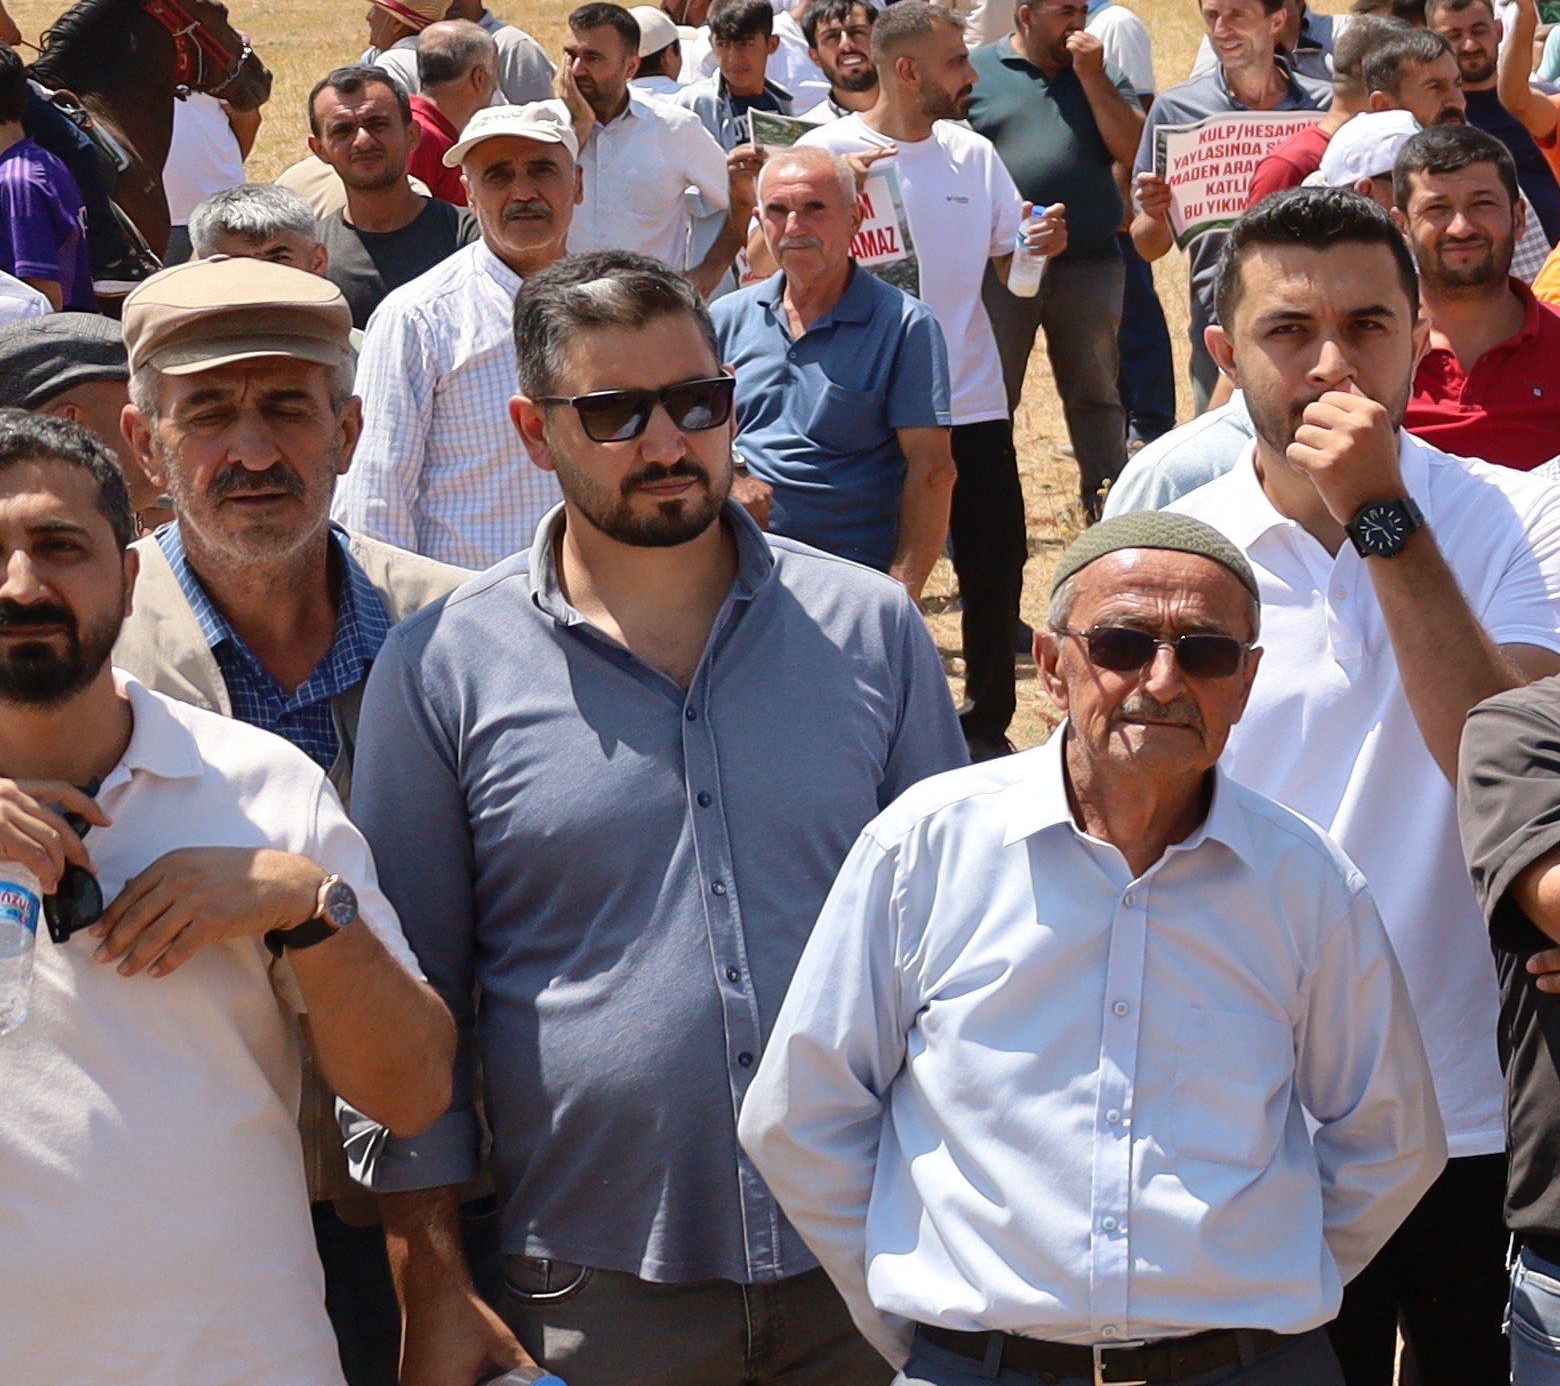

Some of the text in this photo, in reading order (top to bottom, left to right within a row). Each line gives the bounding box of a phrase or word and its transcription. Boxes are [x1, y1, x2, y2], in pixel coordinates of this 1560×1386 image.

[1173, 142, 1262, 171] YAYLASINDA
[1167, 163, 1223, 187] MADEN
[1184, 203, 1203, 220] BU
